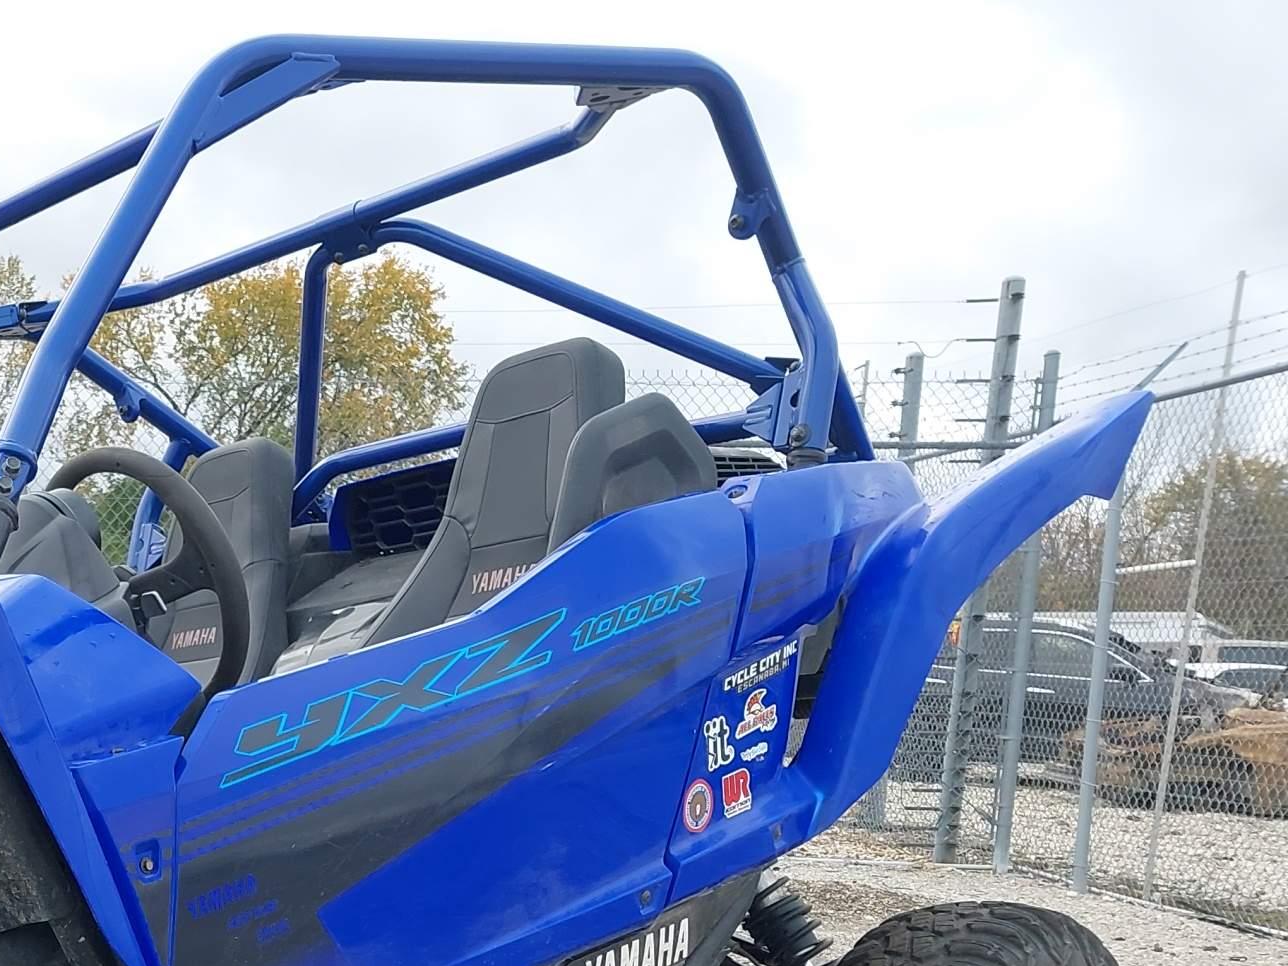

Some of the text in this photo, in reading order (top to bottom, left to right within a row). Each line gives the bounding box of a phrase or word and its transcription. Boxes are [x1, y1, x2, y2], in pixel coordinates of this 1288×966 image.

[172, 626, 217, 650] YAMAHA
[220, 576, 705, 788] YXZ 1000R
[724, 640, 798, 692] CYCLE CITY INC
[723, 770, 750, 807] WR
